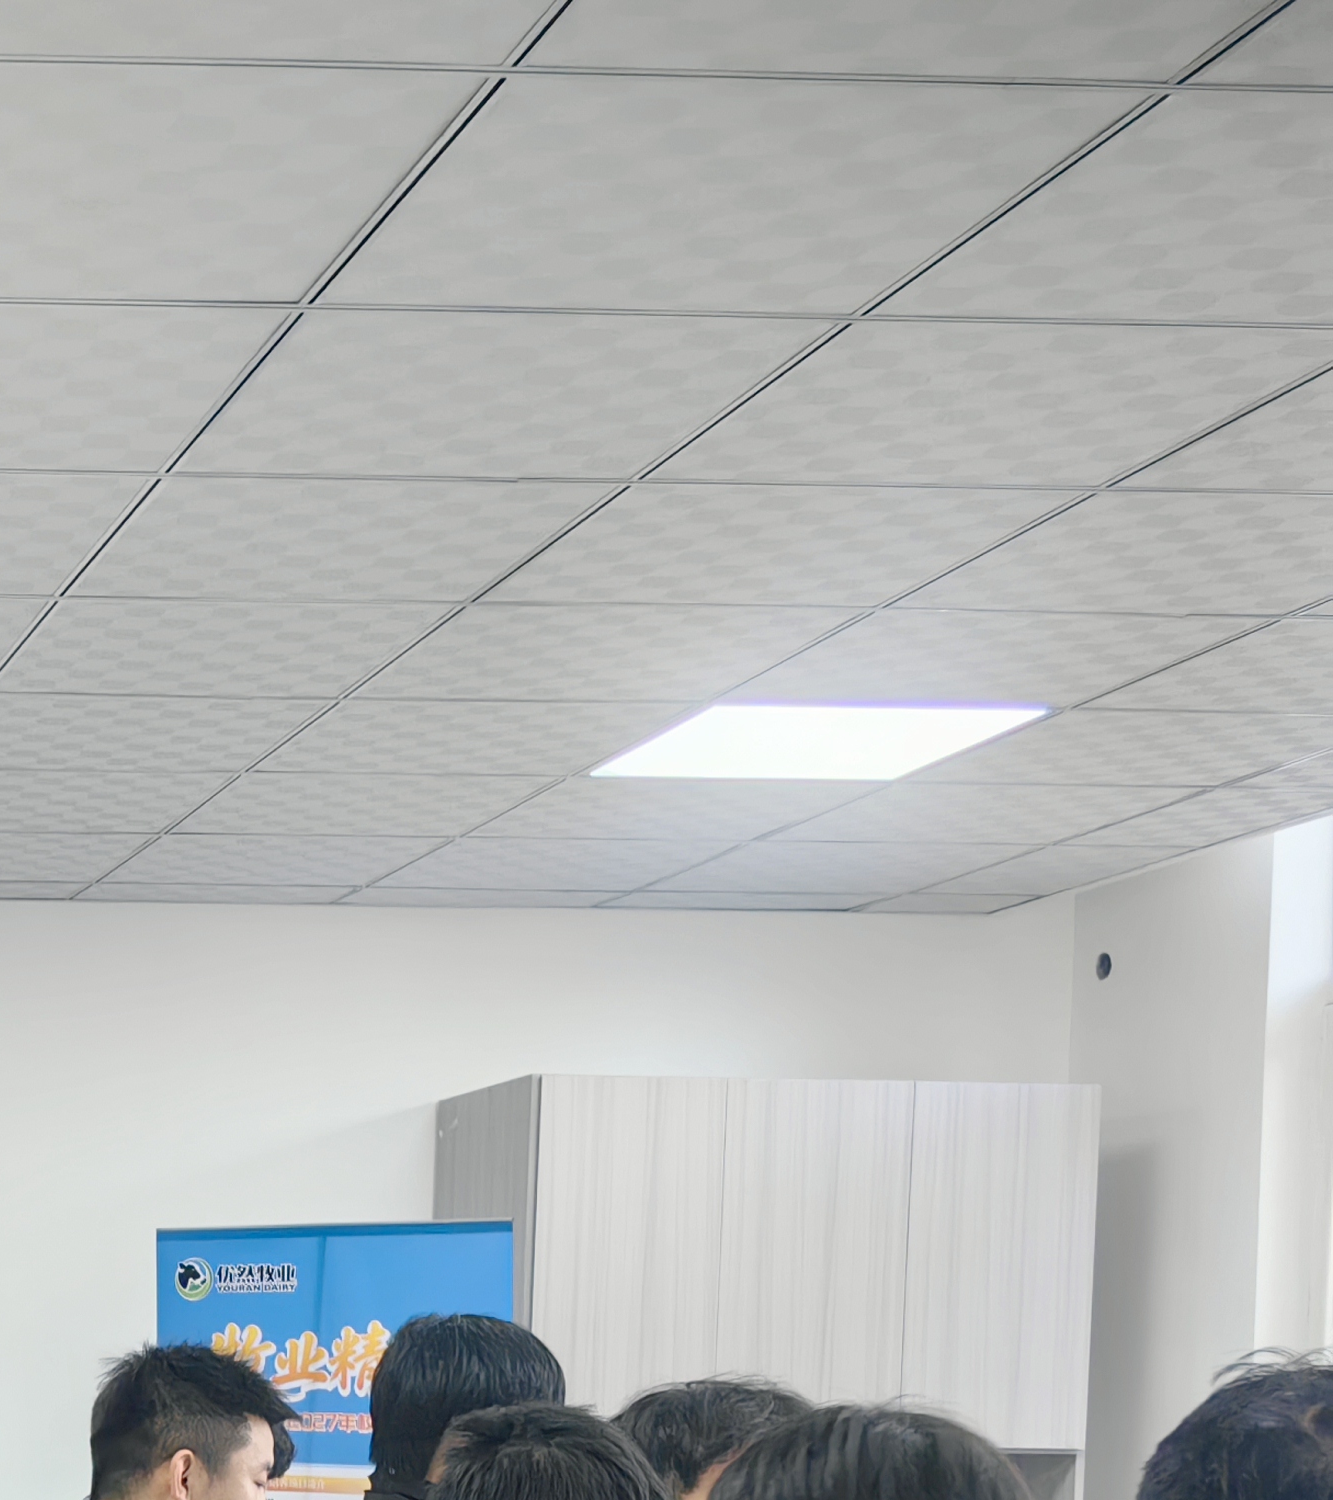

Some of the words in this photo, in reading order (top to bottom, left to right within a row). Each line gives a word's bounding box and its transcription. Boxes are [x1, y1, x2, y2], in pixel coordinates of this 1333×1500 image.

[215, 1263, 297, 1283] 优然牧业
[216, 1283, 261, 1293] YOURAN
[264, 1283, 297, 1292] DAIRY
